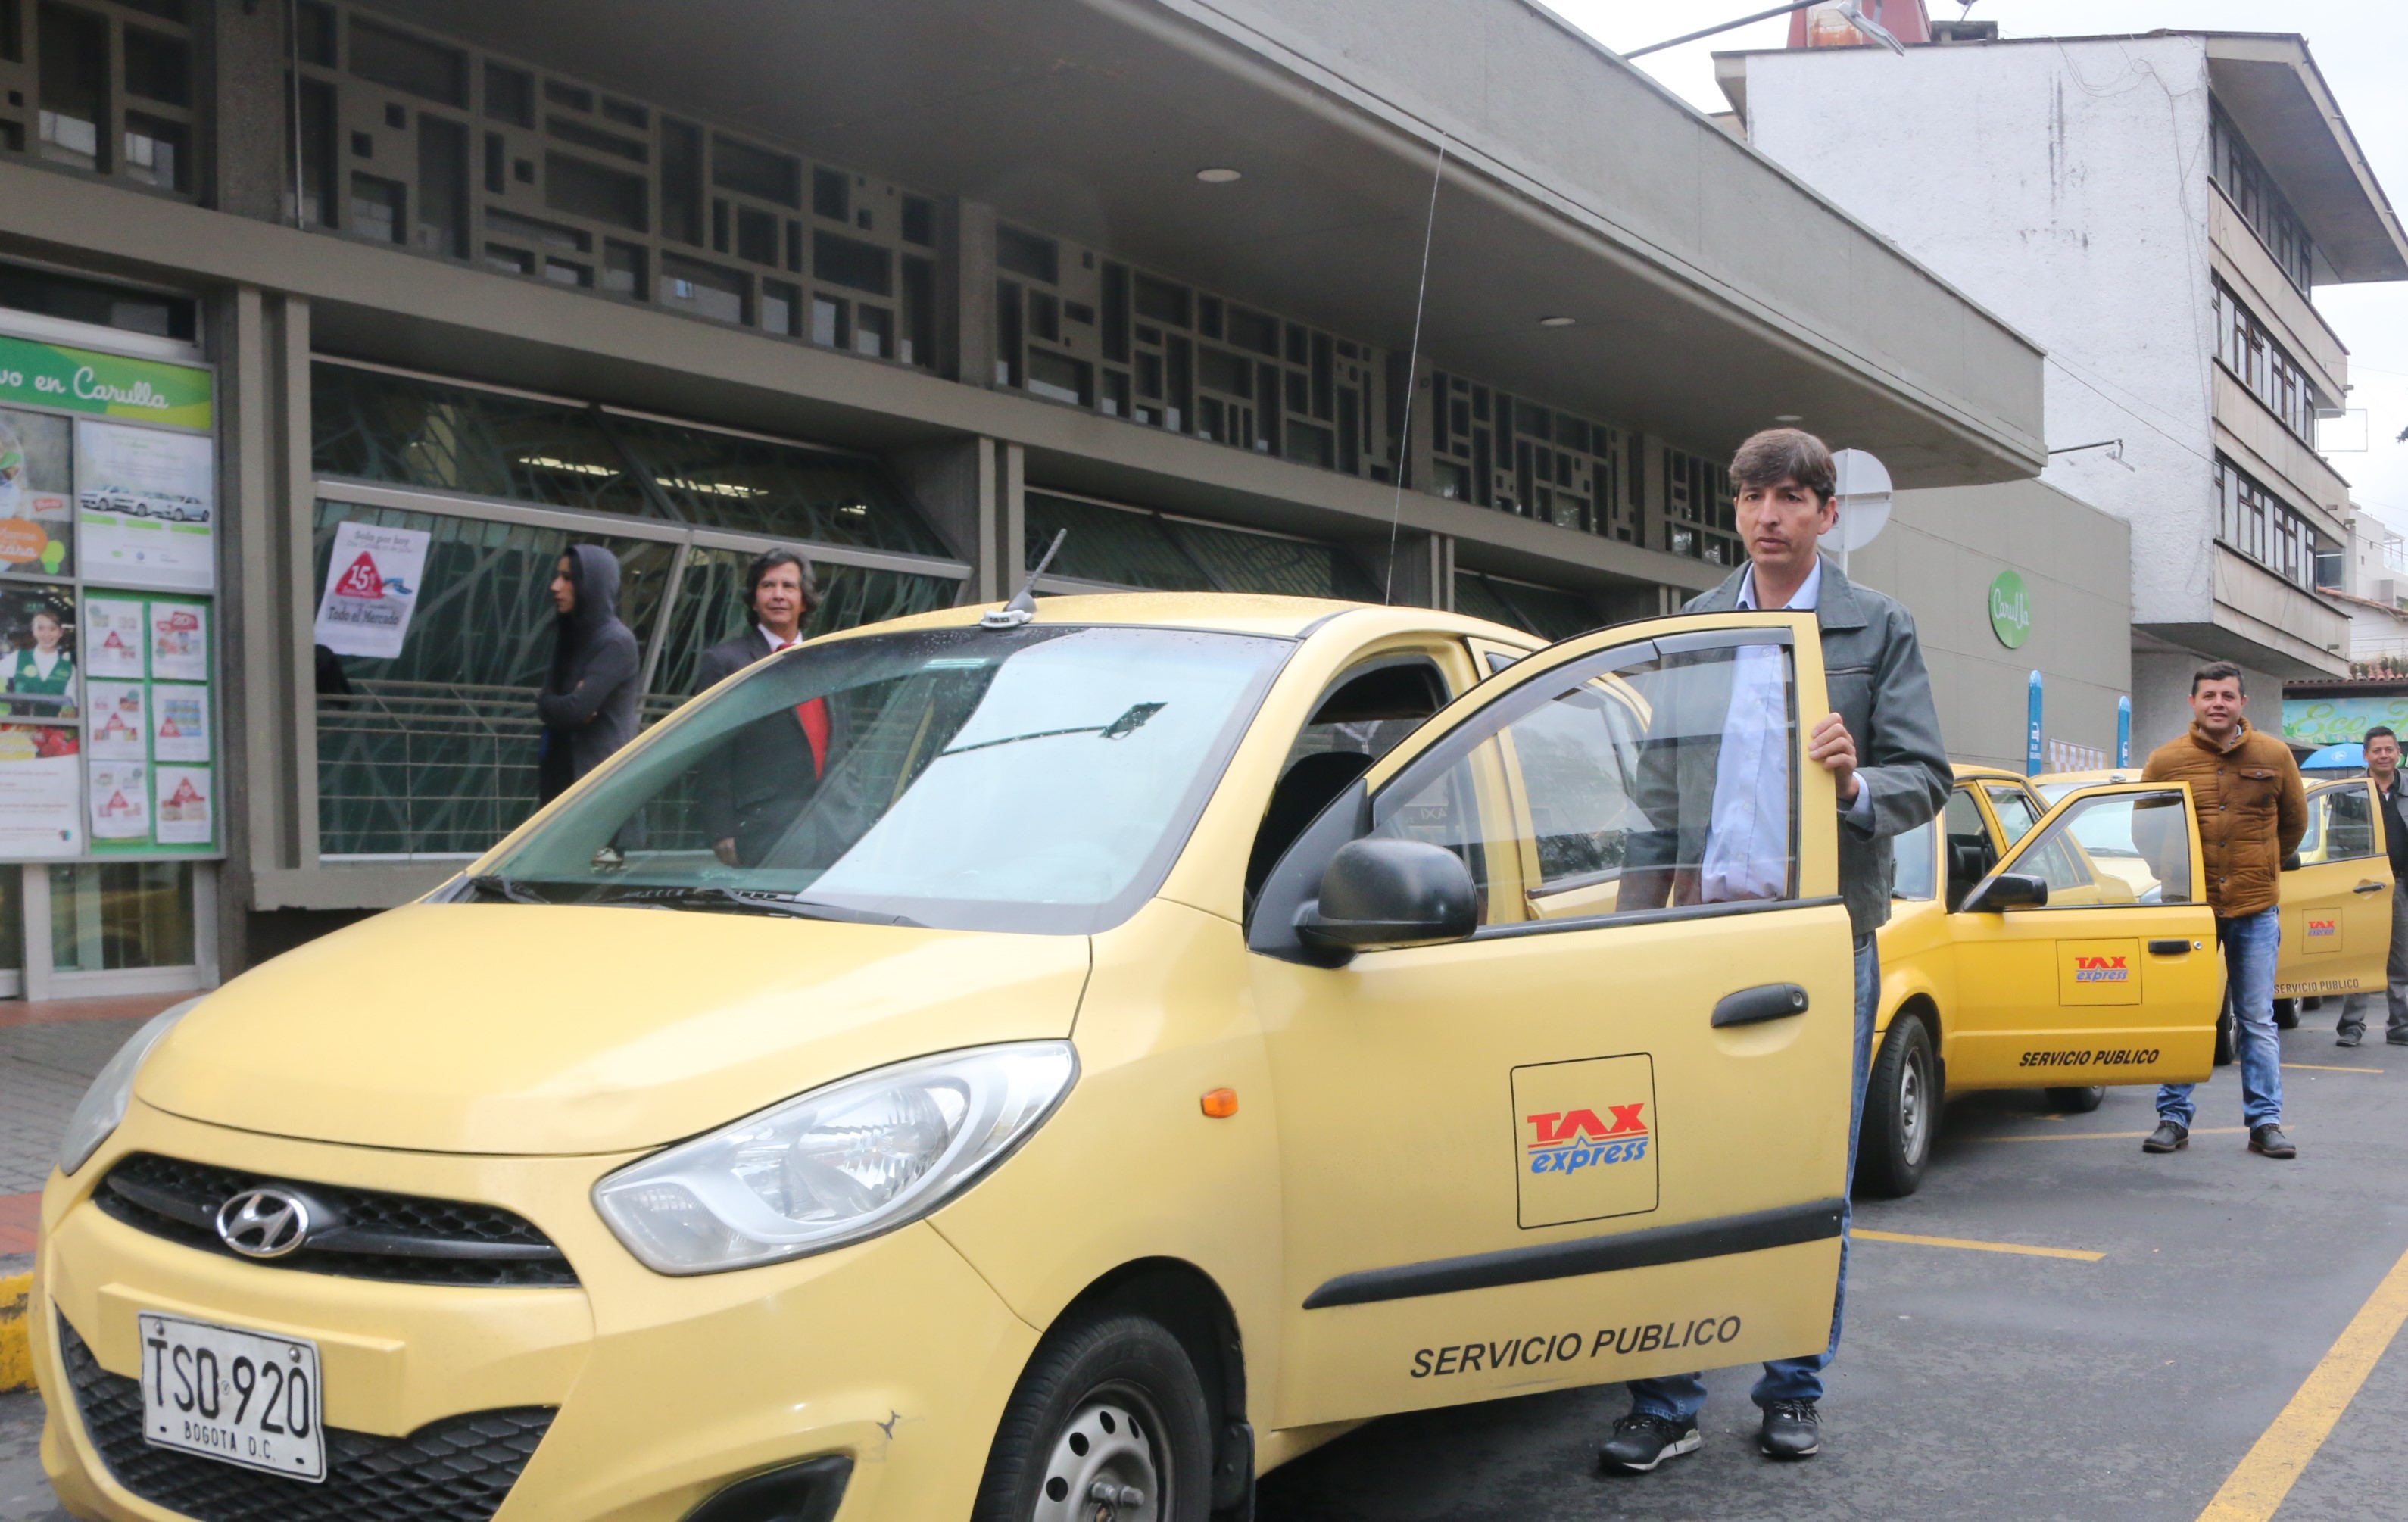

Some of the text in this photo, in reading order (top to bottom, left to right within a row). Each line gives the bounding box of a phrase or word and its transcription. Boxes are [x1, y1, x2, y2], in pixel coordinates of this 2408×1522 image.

[34, 375, 66, 394] en
[73, 366, 170, 409] Carulla
[1993, 587, 2029, 630] Carulla
[2293, 702, 2369, 738] Eco
[2308, 920, 2335, 929] TAX
[2075, 956, 2126, 968] TAX
[2076, 970, 2128, 982] express
[2274, 978, 2359, 994] SERVICIO PUBLICO
[2019, 1049, 2160, 1067] SERVICIO PUBLICO
[1527, 1103, 1648, 1142] TAX
[1530, 1140, 1648, 1174] express
[1410, 1315, 1742, 1378] SERVICIO PUBLICO
[232, 1355, 310, 1439] 920
[183, 1421, 277, 1462] BOGOTA D.C.
